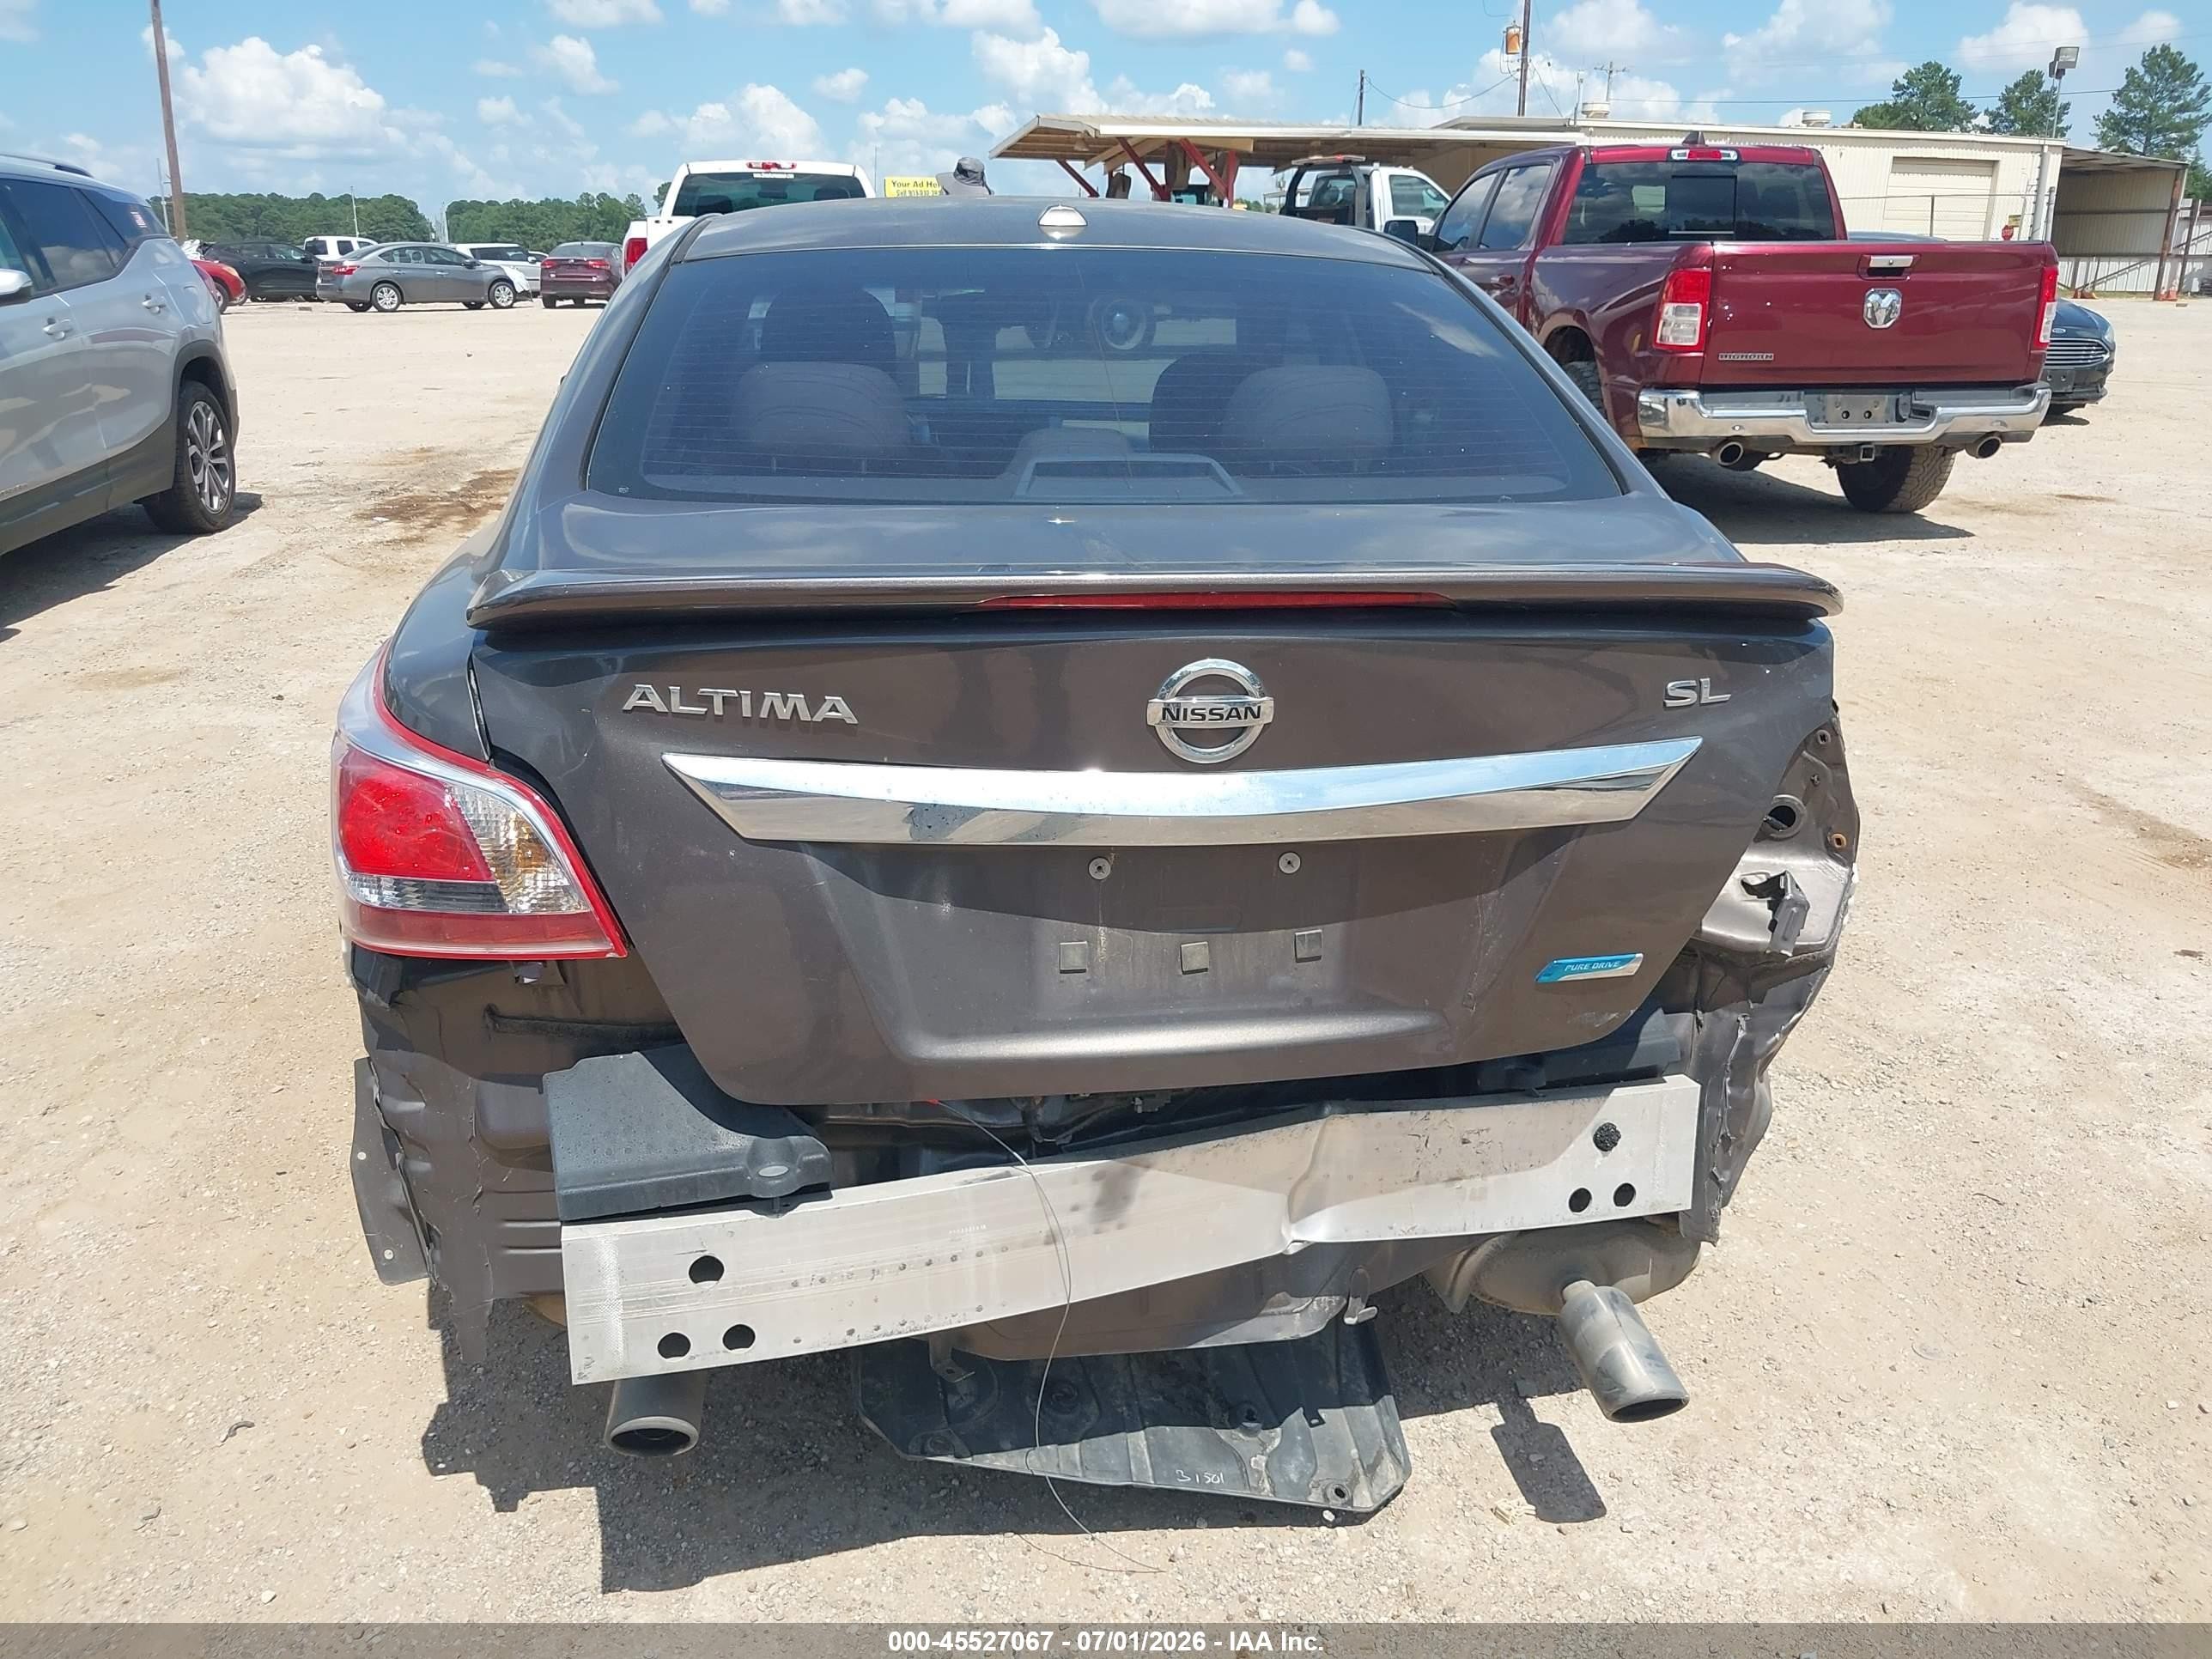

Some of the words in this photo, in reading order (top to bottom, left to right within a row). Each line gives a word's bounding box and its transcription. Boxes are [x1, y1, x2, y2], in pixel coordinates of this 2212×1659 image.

[622, 684, 859, 724] ALTIMA
[1663, 678, 1732, 708] SL
[1162, 705, 1261, 722] NISSAN
[1564, 963, 1590, 972] PURE
[1591, 960, 1621, 969] DRIVE
